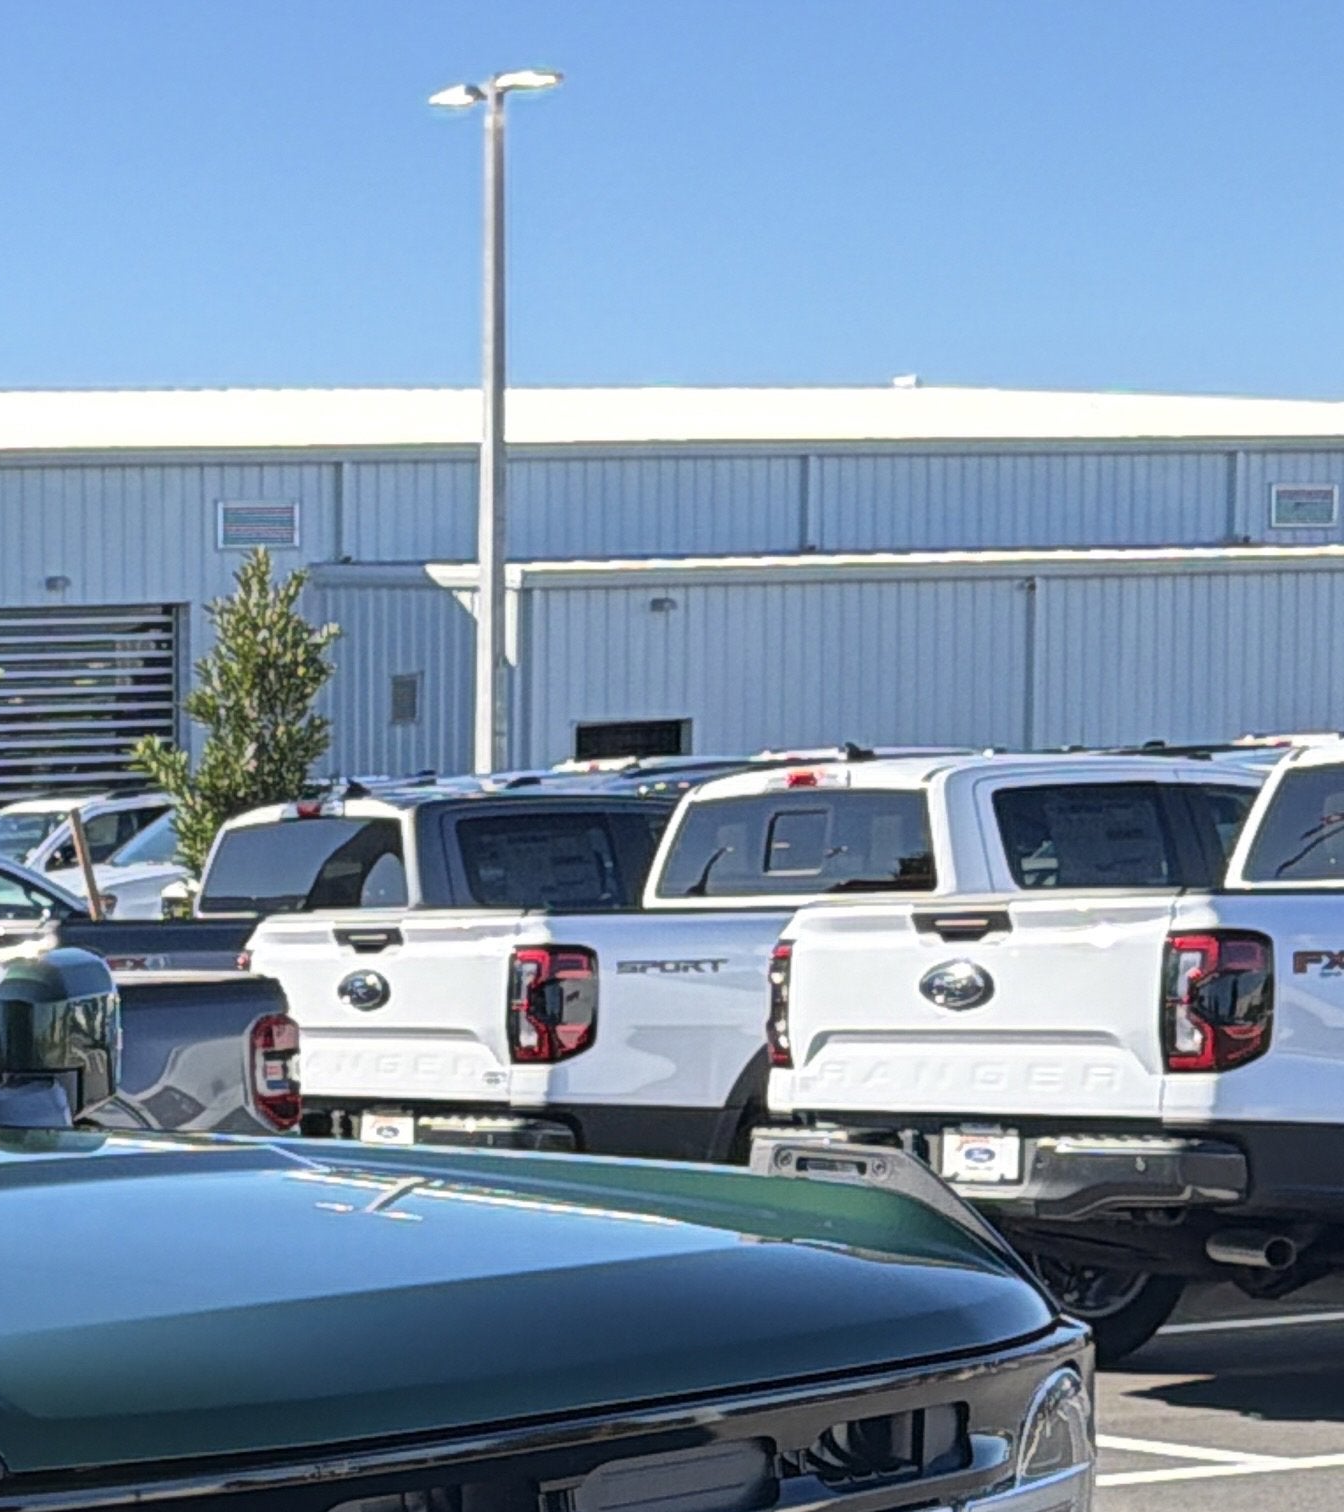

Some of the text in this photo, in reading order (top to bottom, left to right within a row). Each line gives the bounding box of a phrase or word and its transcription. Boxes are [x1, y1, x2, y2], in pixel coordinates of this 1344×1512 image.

[616, 958, 729, 975] SPORT
[304, 1051, 483, 1081] ANGER
[818, 1058, 1123, 1092] RANGER
